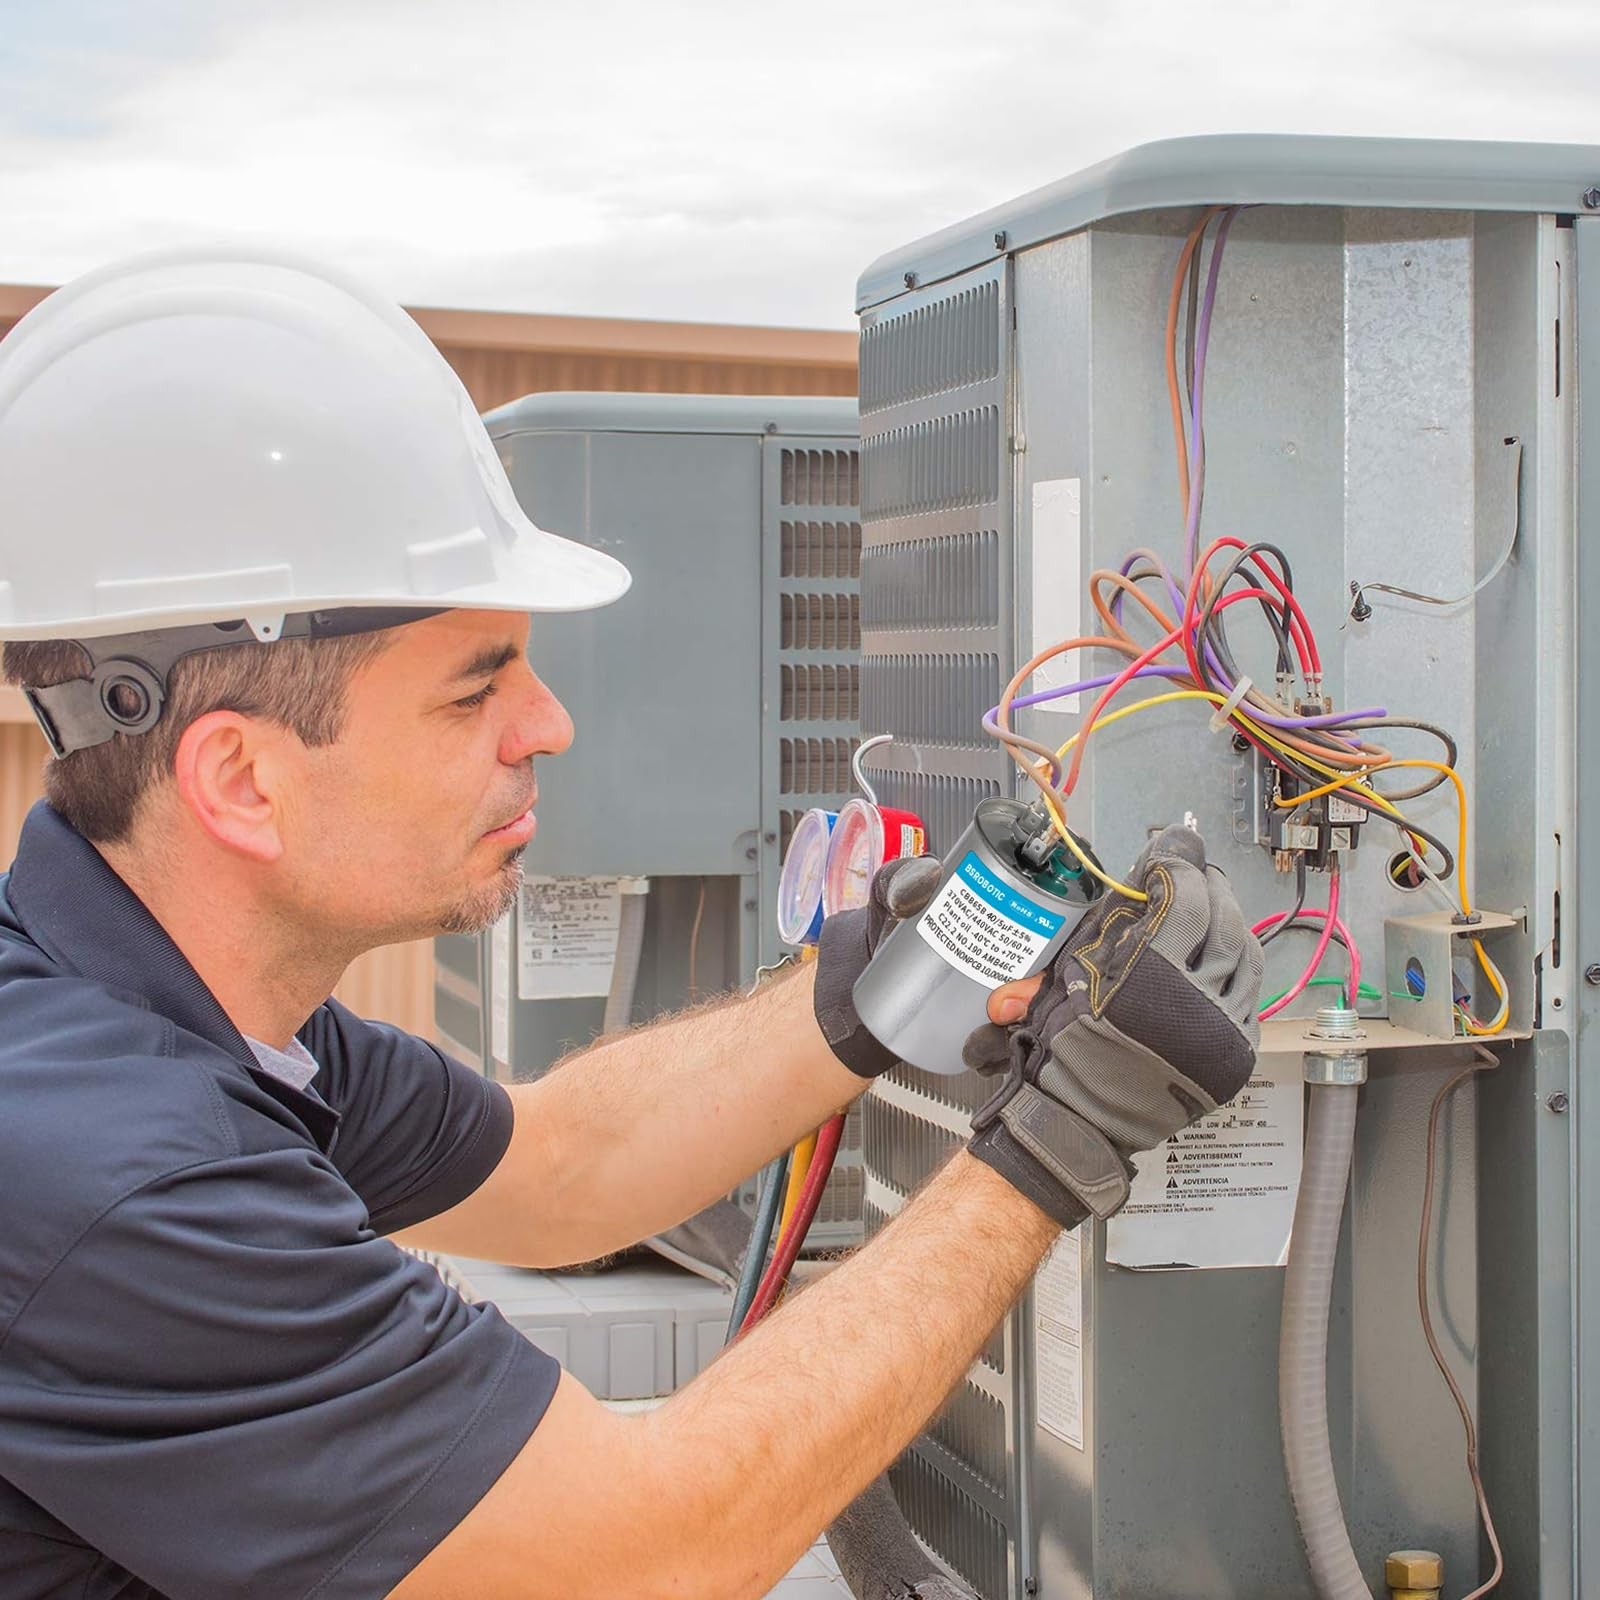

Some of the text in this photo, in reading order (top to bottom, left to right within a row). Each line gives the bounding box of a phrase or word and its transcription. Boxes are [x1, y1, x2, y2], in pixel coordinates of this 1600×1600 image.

[959, 888, 987, 914] CBB65B
[964, 863, 1006, 902] BSROBOTIC
[938, 912, 1016, 973] C22.2 NO.190 AMB46C
[943, 901, 961, 923] Plant
[960, 921, 972, 933] oil
[990, 943, 1000, 953] to
[946, 889, 1035, 956] 370VAC/440VAC 50/60 Hz
[924, 914, 1016, 983] PROTECTED NONPCB 10,000AF
[1183, 1153, 1242, 1161] ADVERTISSEMENT
[1184, 1133, 1217, 1141] WARNING
